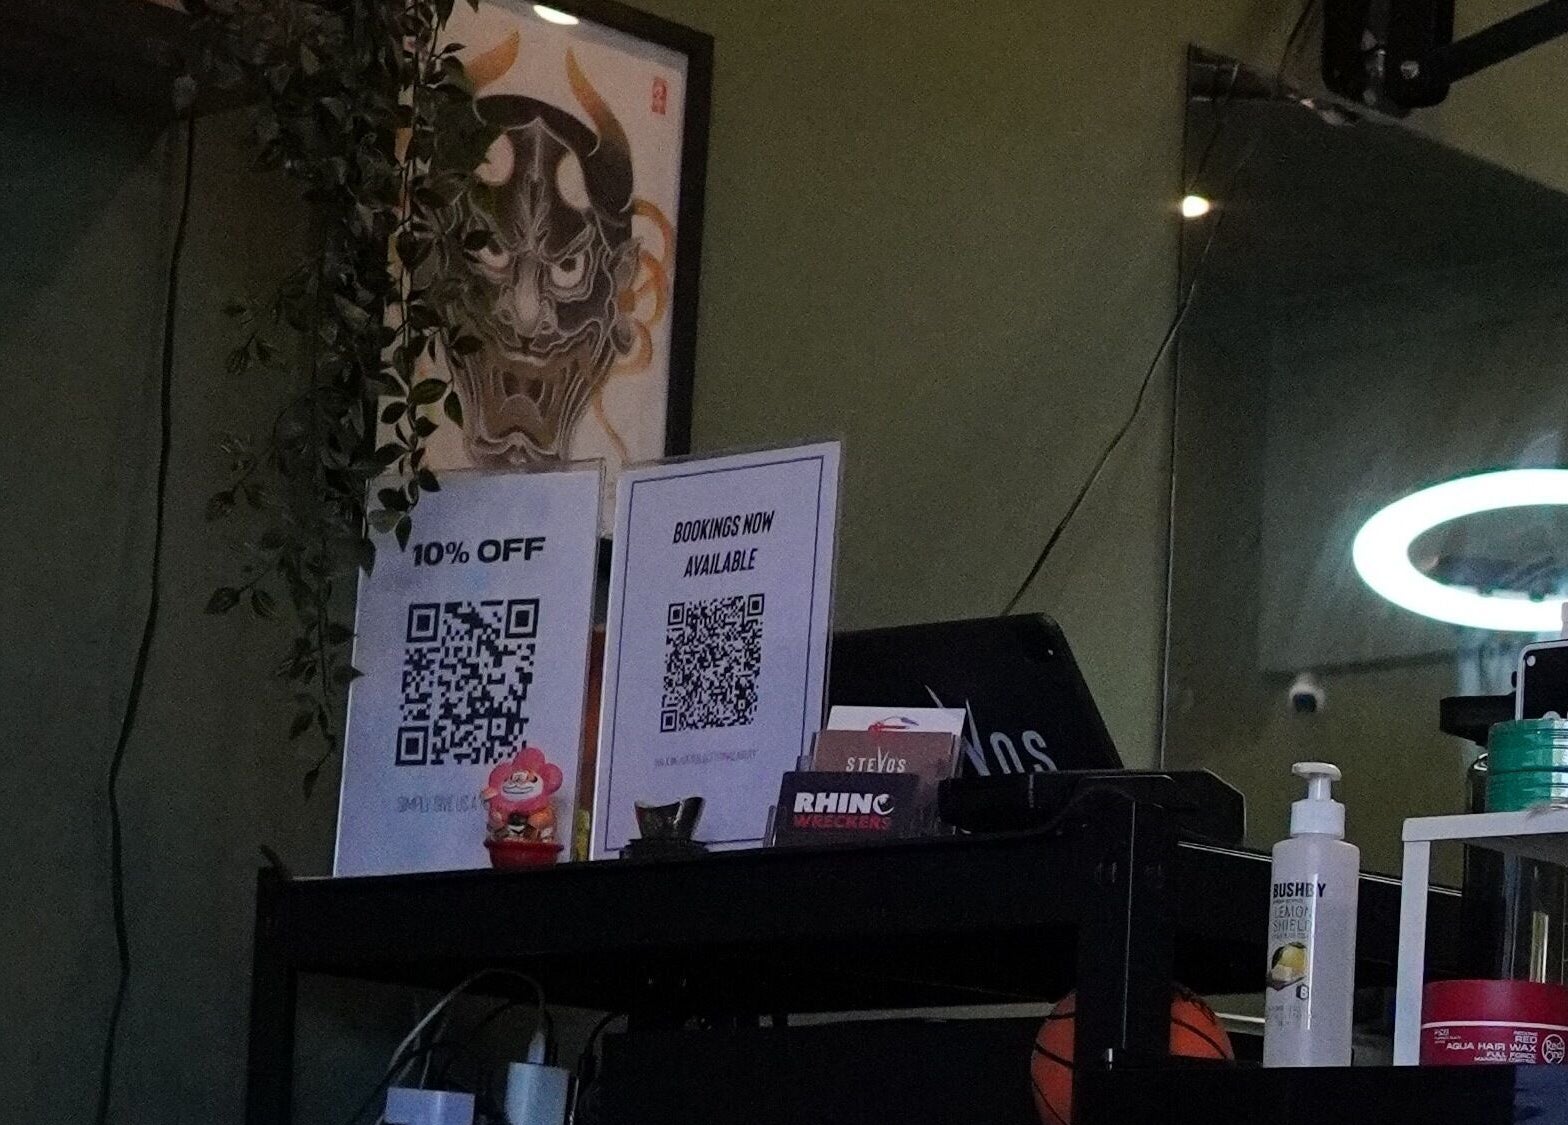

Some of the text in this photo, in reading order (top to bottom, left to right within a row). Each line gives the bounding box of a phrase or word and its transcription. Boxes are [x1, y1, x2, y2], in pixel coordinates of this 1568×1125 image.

[672, 509, 776, 545] BOOKINGS NOW
[412, 536, 547, 567] 10% OFF
[683, 547, 758, 578] AVAILABLE
[792, 814, 893, 831] WRECKERS
[1272, 882, 1327, 898] BUSHBY
[1446, 1041, 1537, 1053] AQUA HAIR WAX
[1514, 1035, 1538, 1044] RED
[1545, 1039, 1566, 1051] Red
